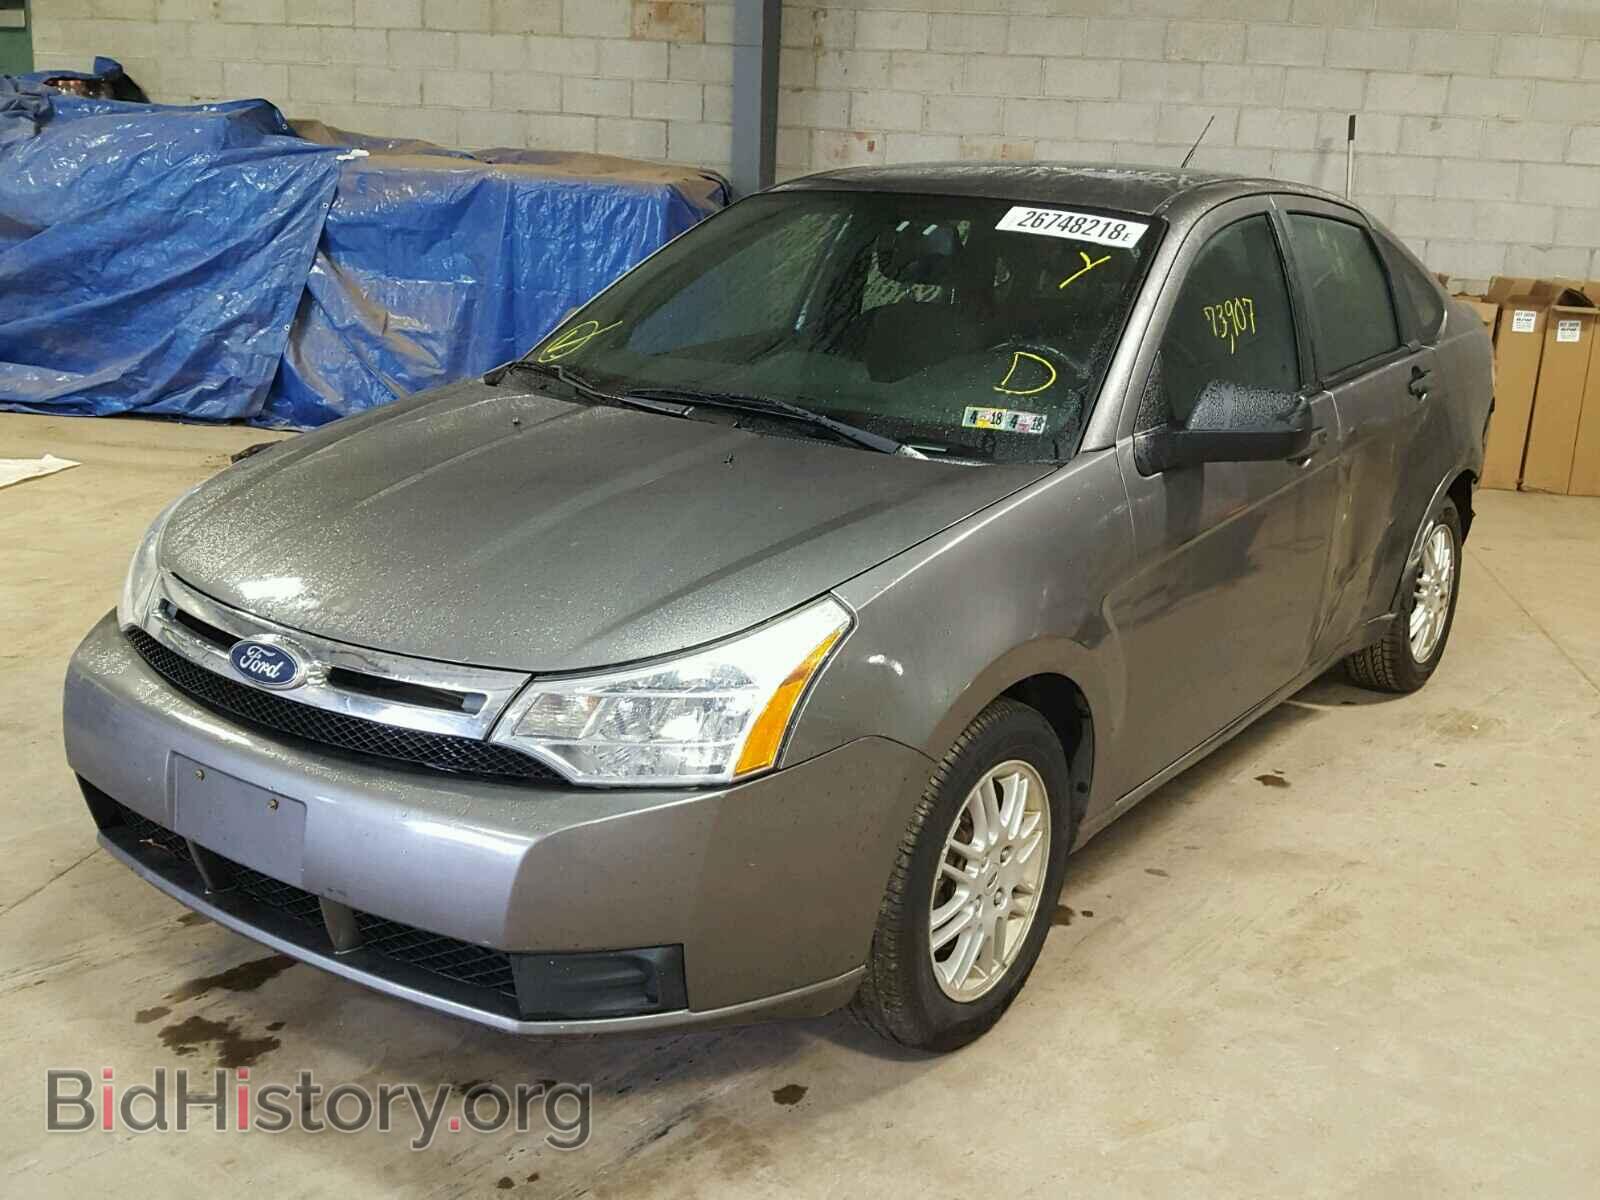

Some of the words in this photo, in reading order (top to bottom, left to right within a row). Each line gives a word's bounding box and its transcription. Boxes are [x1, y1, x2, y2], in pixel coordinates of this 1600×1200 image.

[992, 351, 1057, 395] D
[990, 411, 1003, 425] 18
[239, 645, 284, 679] Ford
